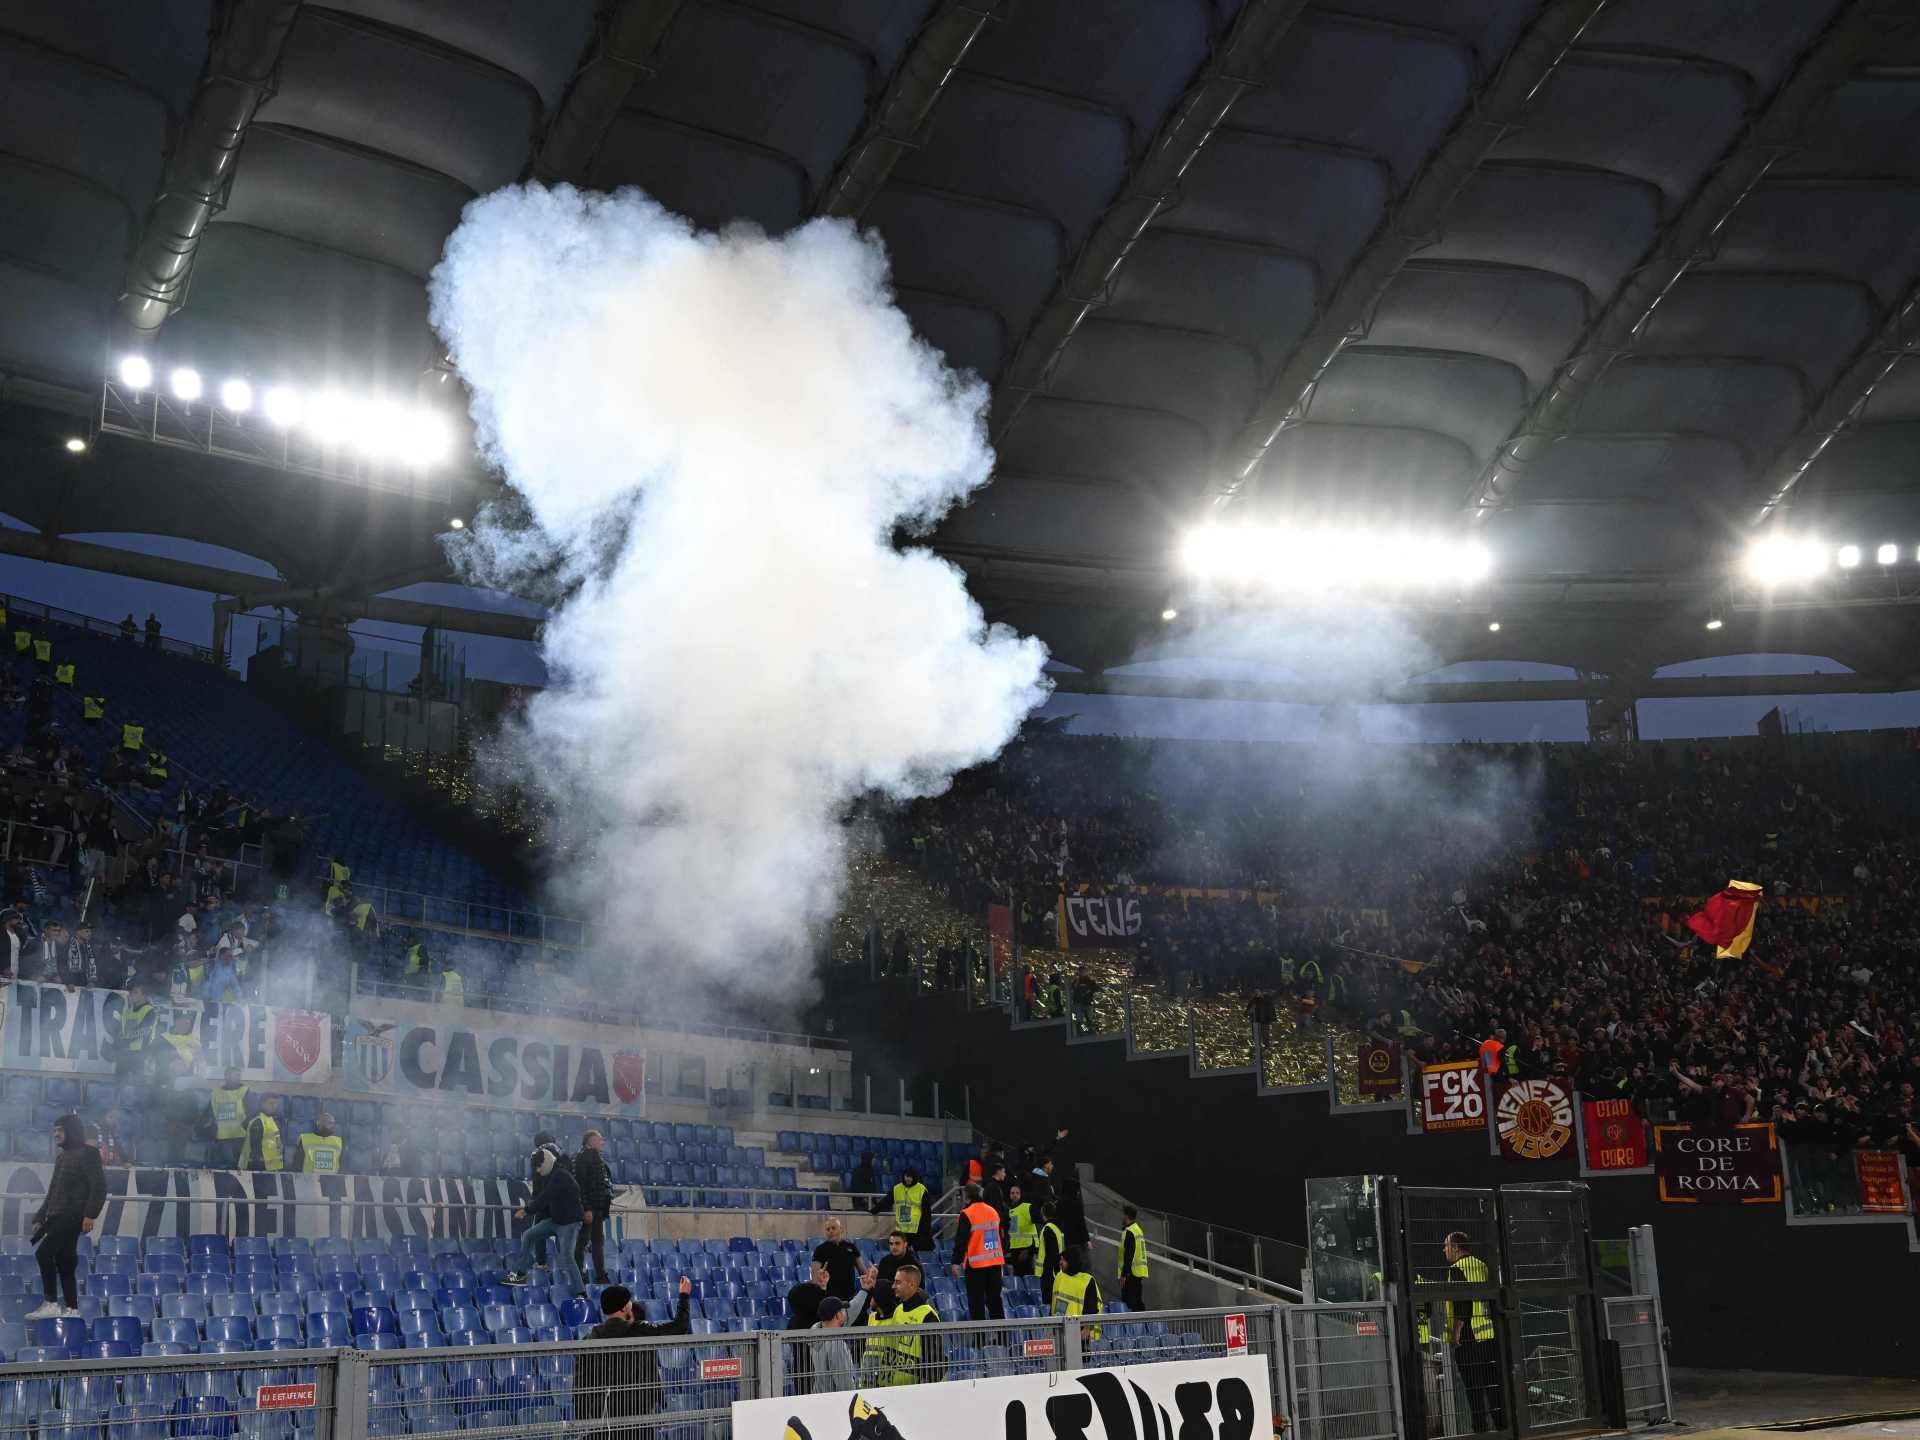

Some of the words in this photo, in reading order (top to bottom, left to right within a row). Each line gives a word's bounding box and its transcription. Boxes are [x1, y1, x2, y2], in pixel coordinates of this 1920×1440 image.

[17, 985, 266, 1070] TRASERE
[401, 1026, 612, 1105] CASSIA
[1422, 1068, 1481, 1097] FCK
[1425, 1093, 1484, 1122] LZO
[1497, 1079, 1573, 1133] VENEZIA
[1596, 1099, 1631, 1118] CIAO
[1501, 1123, 1572, 1160] CREW
[1677, 1136, 1752, 1154] CORE
[1699, 1156, 1735, 1172] DE
[1677, 1174, 1760, 1191] ROMA
[2, 1166, 191, 1245] GZZI
[213, 1171, 296, 1242] DEI
[319, 1174, 533, 1243] TASSINAR
